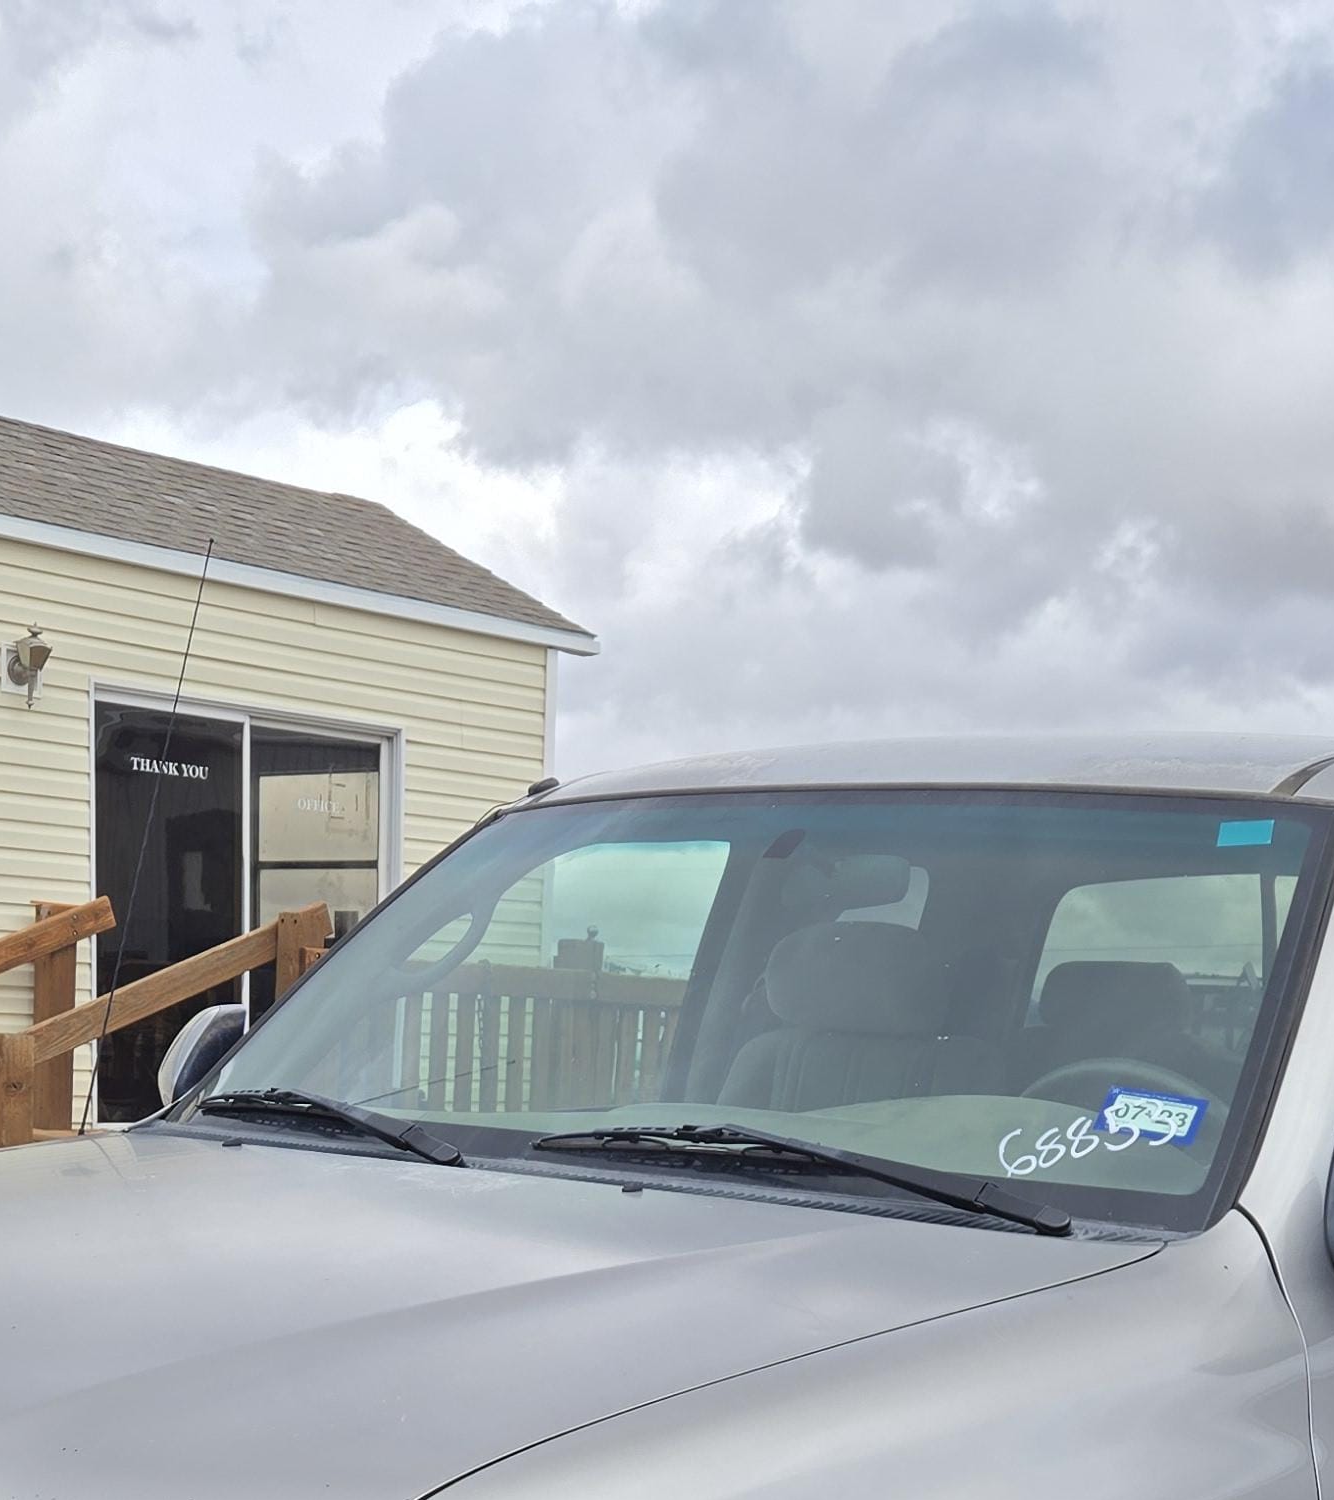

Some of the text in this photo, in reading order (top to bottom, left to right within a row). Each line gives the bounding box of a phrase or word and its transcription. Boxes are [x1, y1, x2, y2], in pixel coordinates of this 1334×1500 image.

[130, 756, 209, 780] THANK YOU
[297, 797, 341, 814] OFFICE
